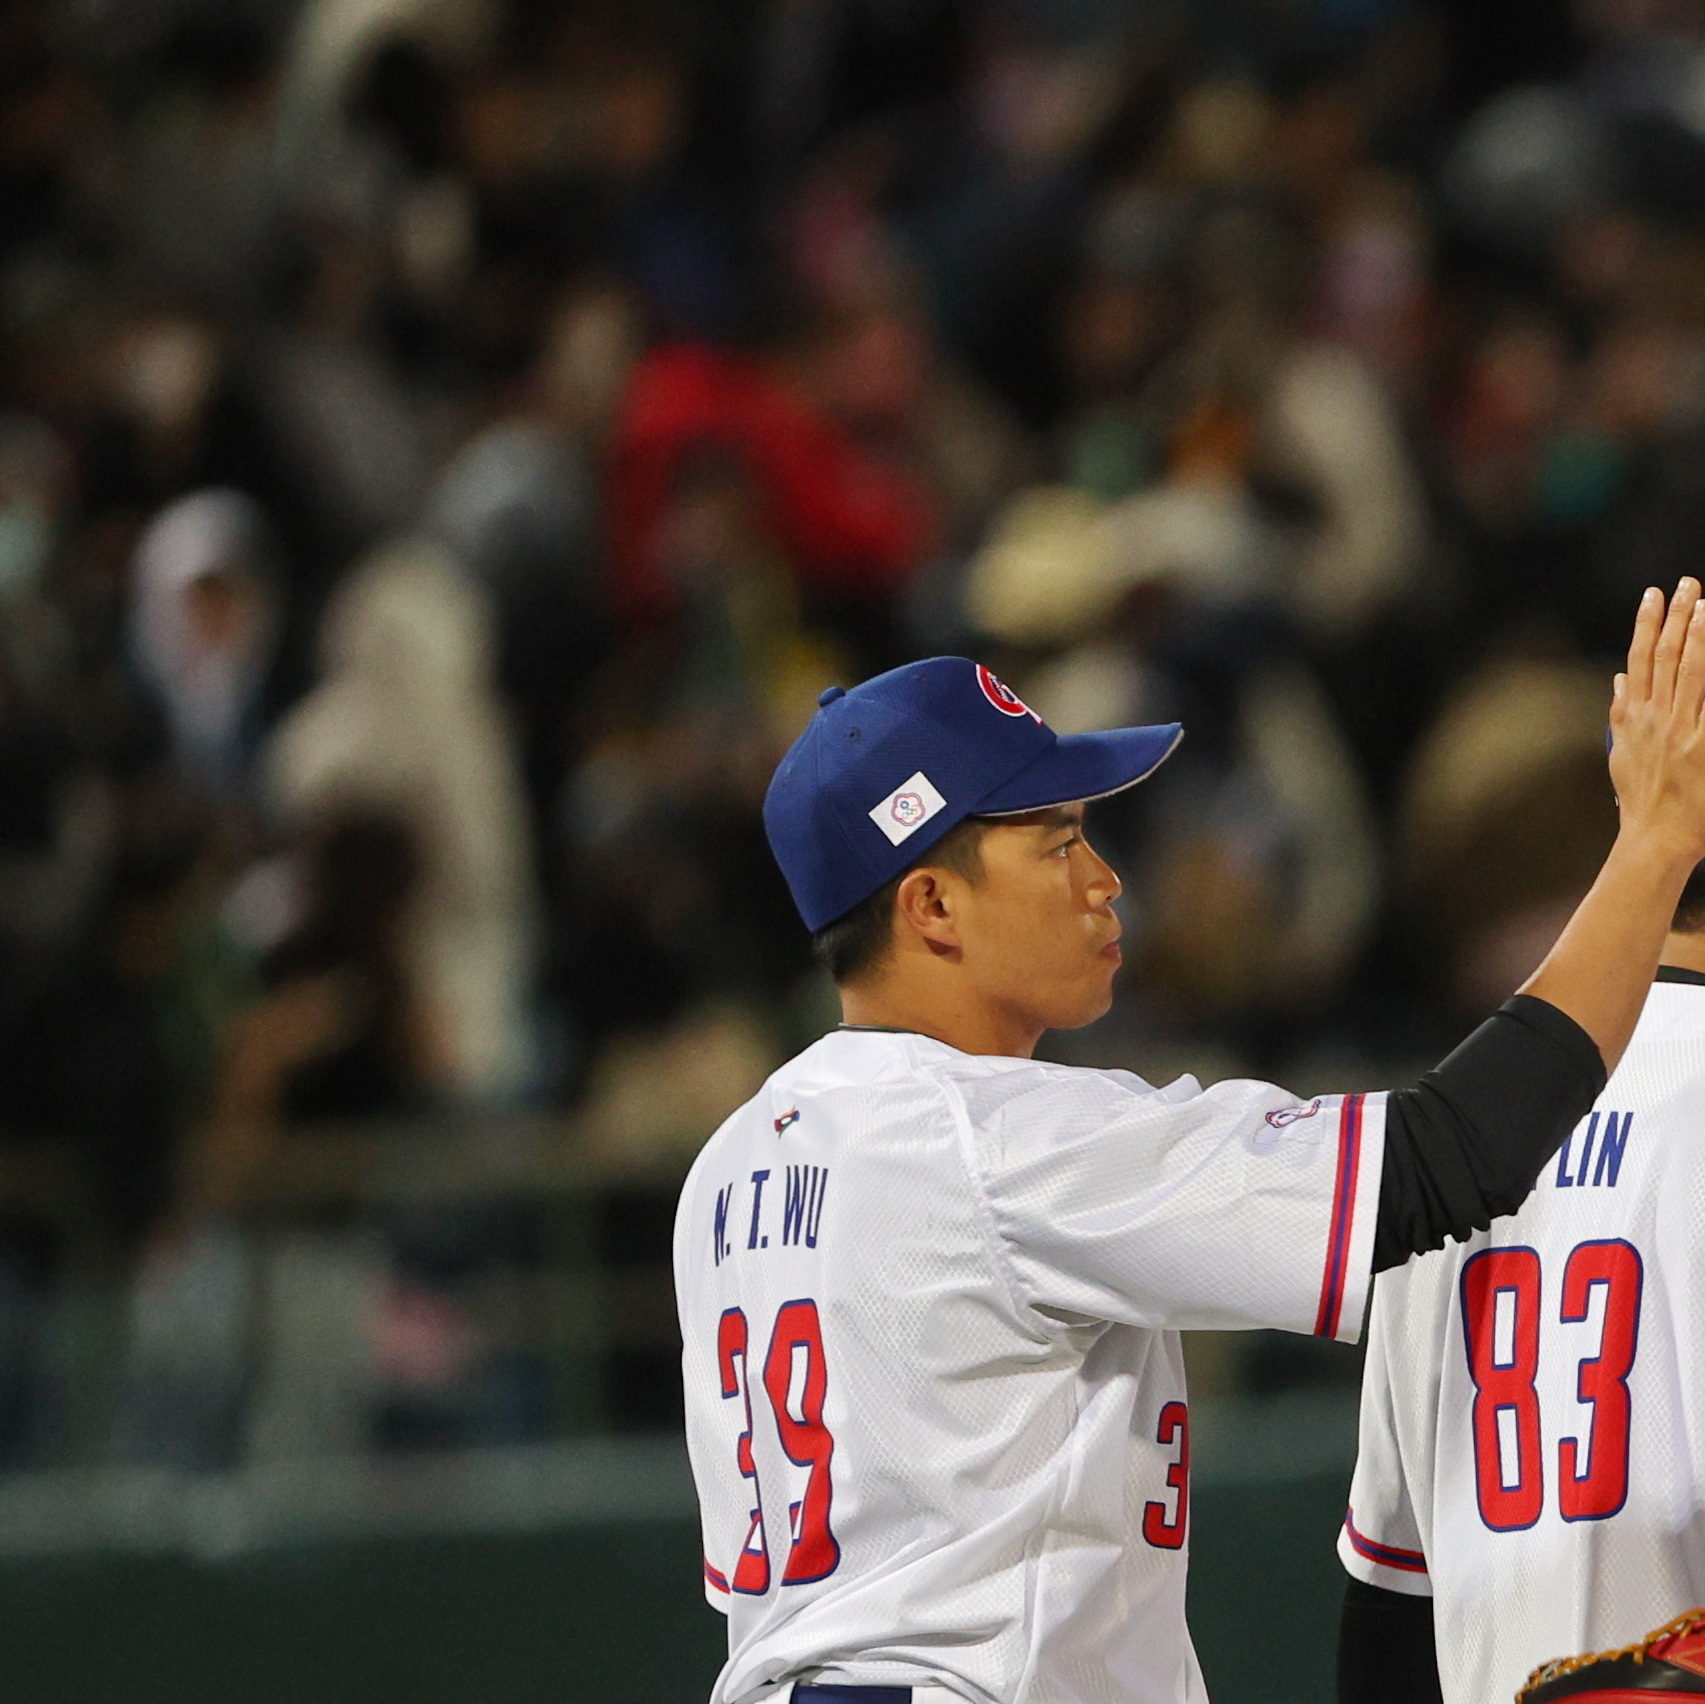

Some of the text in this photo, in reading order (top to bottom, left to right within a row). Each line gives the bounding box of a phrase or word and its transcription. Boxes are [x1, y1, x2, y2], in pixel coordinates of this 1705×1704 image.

[782, 1164, 829, 1250] WU
[1555, 1110, 1635, 1188] LIN
[717, 1297, 841, 1597] 39
[1460, 1237, 1644, 1533] 83
